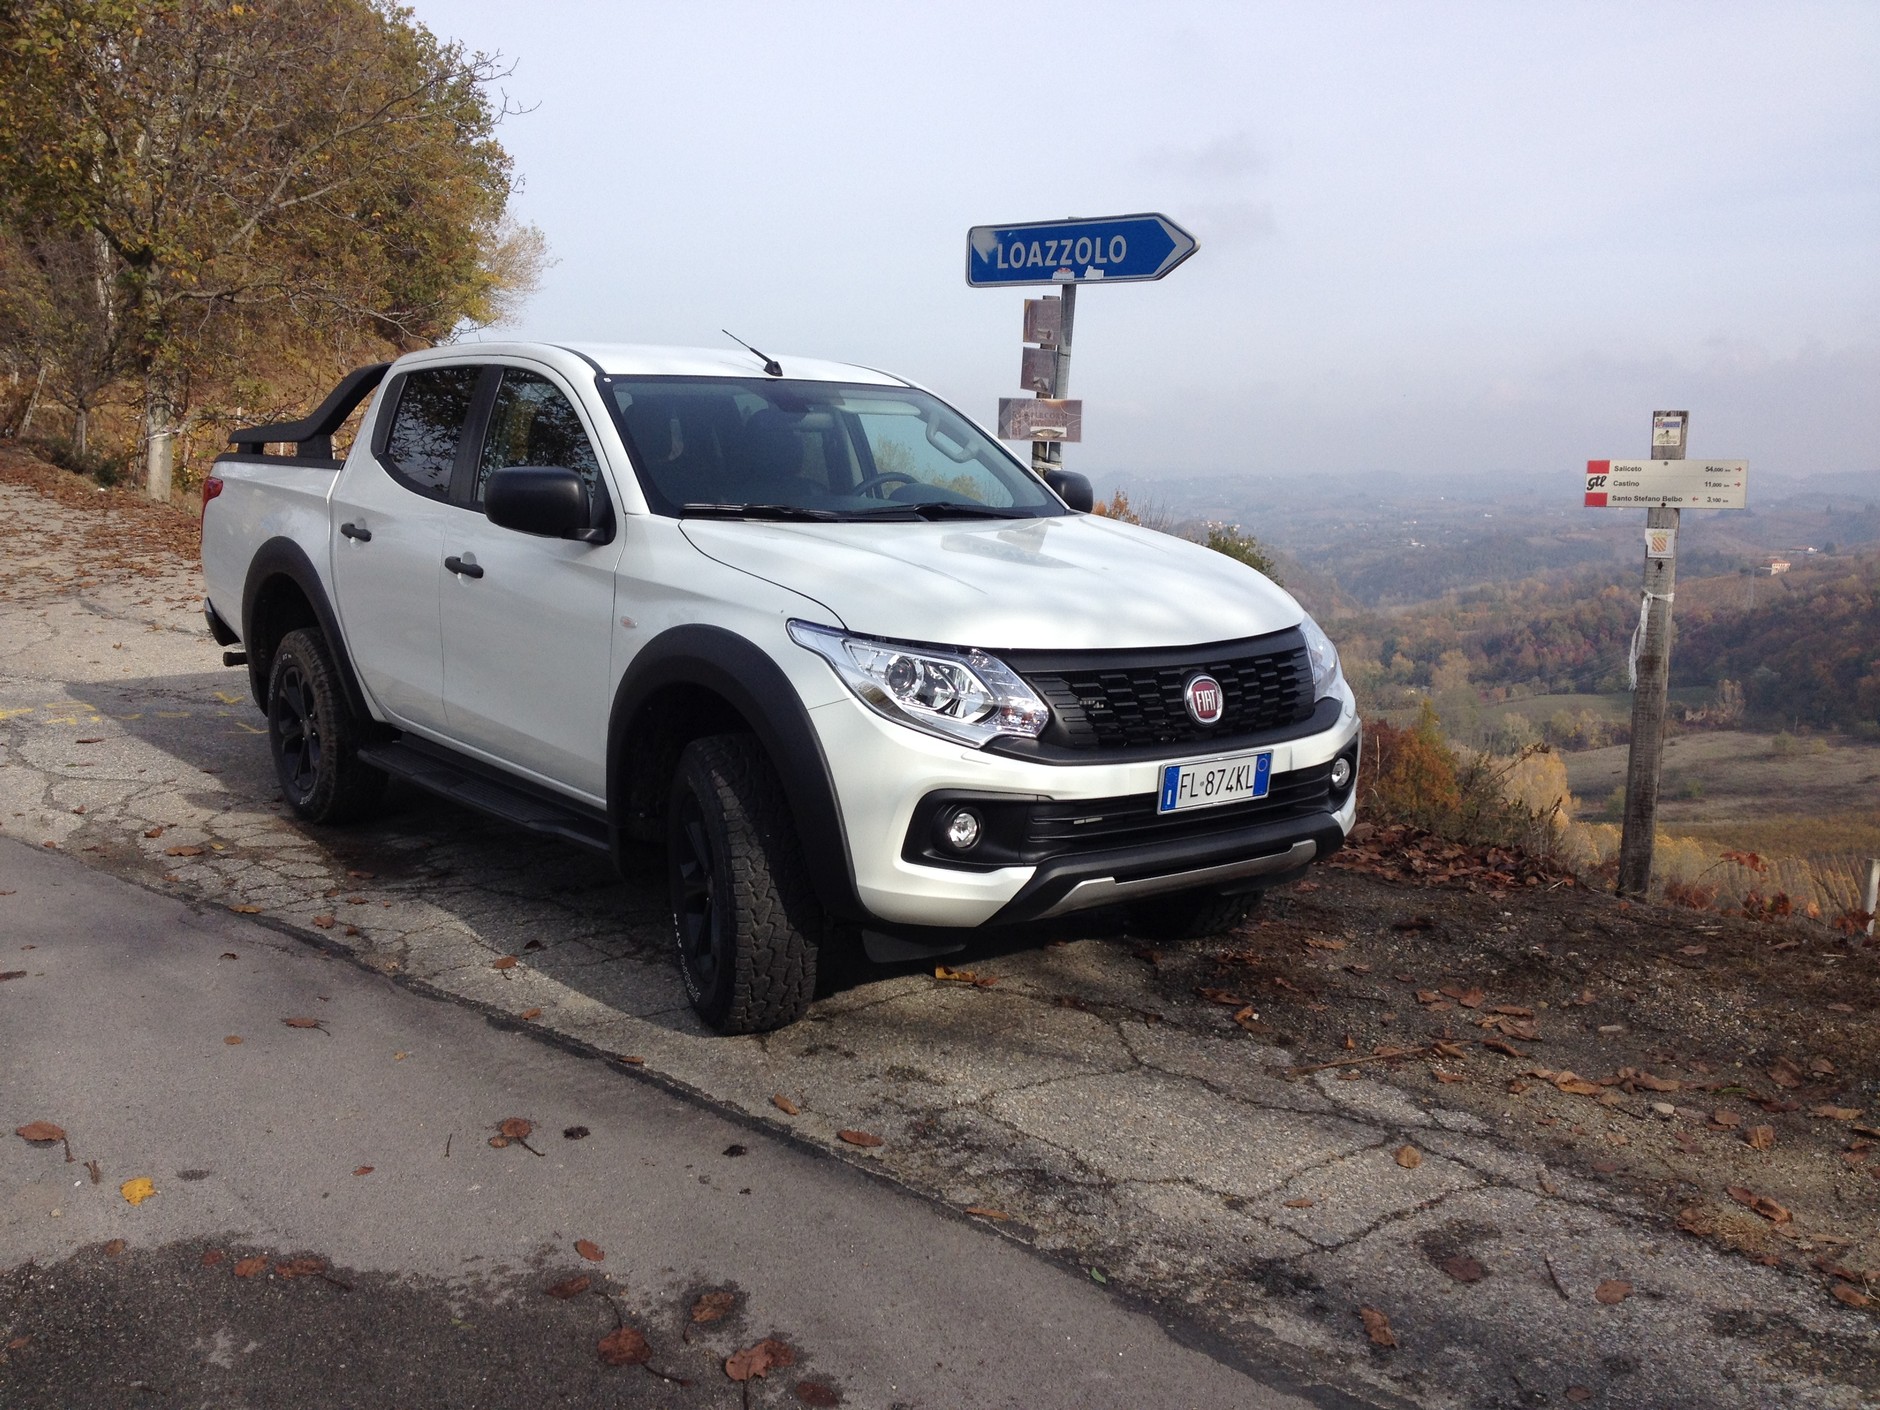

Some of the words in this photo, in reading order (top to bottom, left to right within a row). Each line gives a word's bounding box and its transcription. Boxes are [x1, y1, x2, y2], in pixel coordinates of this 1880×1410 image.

[997, 235, 1127, 269] LOAZZOLO
[1586, 475, 1608, 491] gtl
[1195, 689, 1217, 712] FIAT
